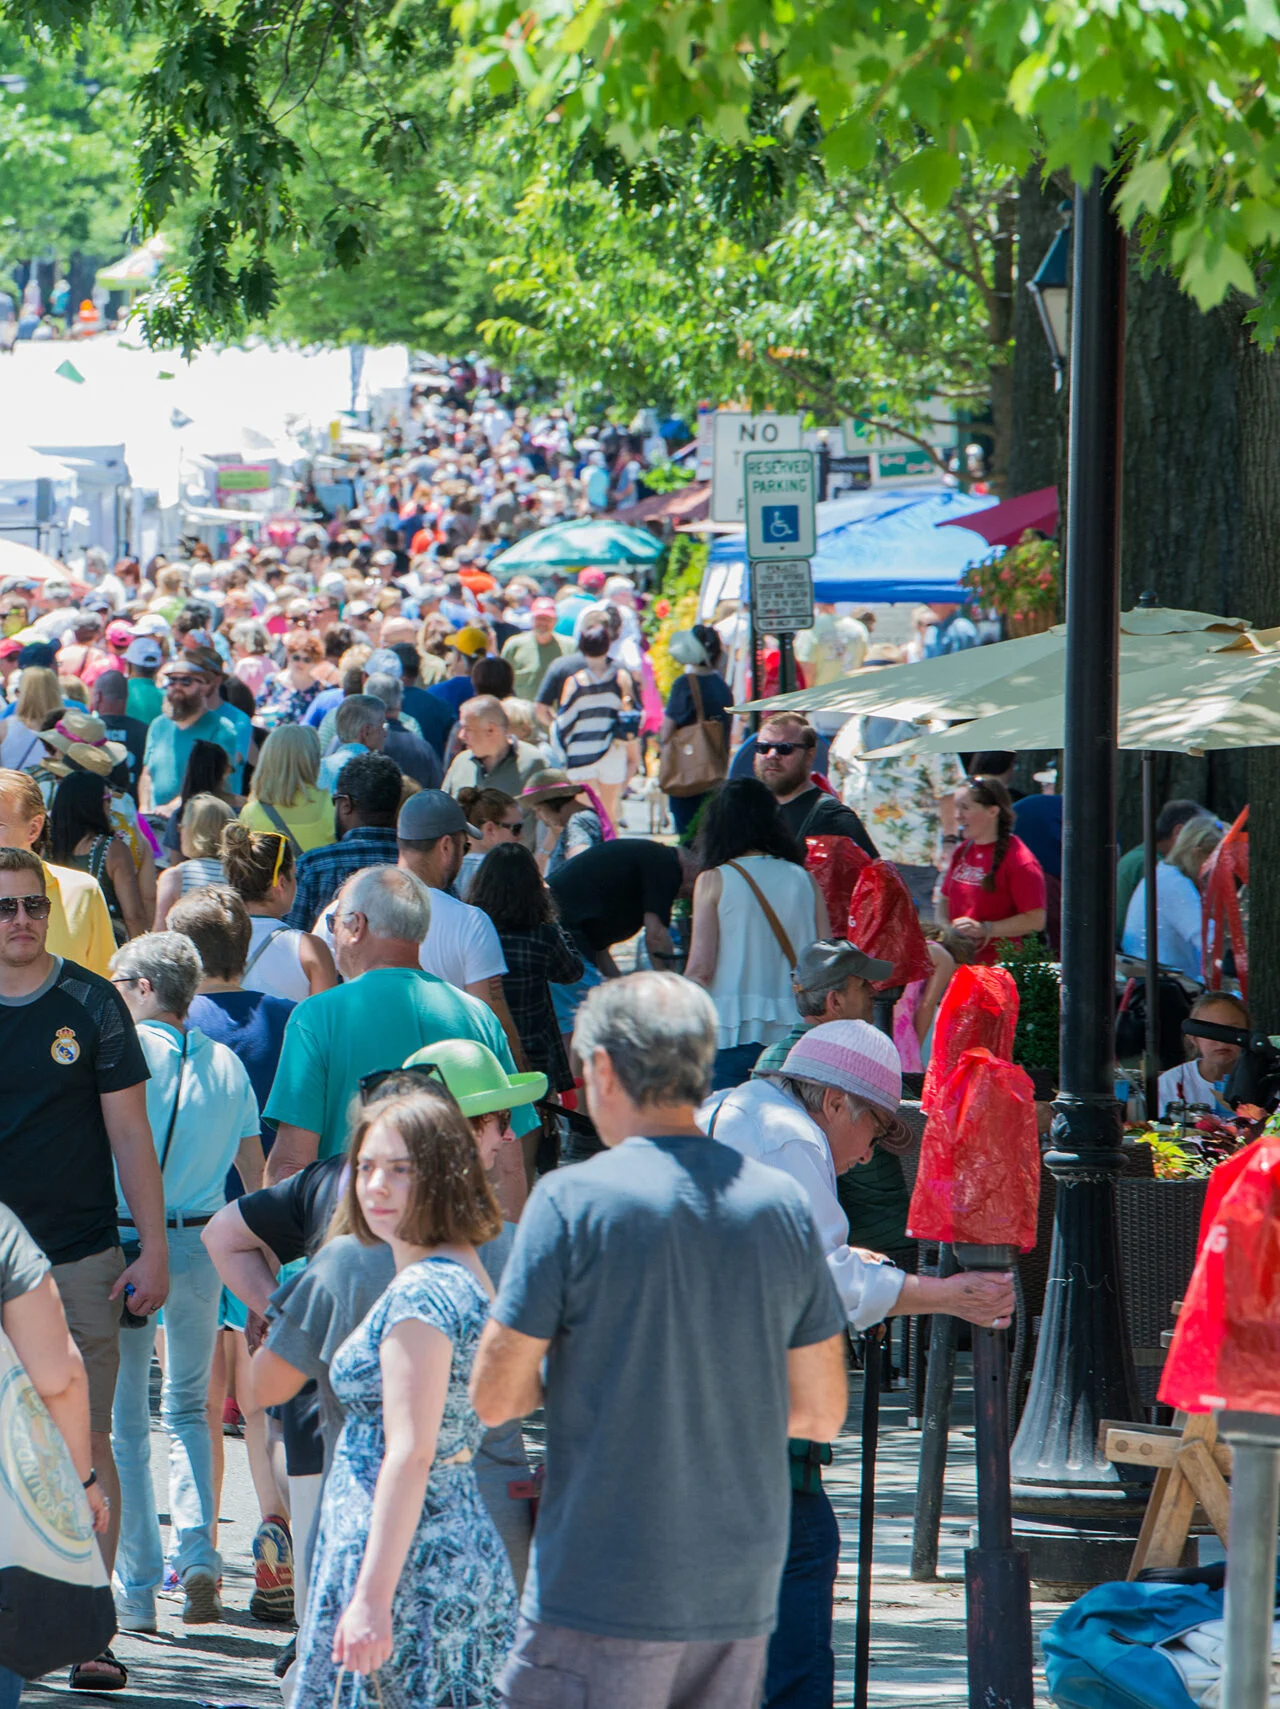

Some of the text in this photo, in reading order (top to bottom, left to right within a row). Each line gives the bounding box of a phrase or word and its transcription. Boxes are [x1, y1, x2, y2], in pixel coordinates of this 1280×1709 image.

[740, 423, 778, 443] NO
[747, 459, 810, 475] RESERVED
[752, 479, 807, 493] PARKING
